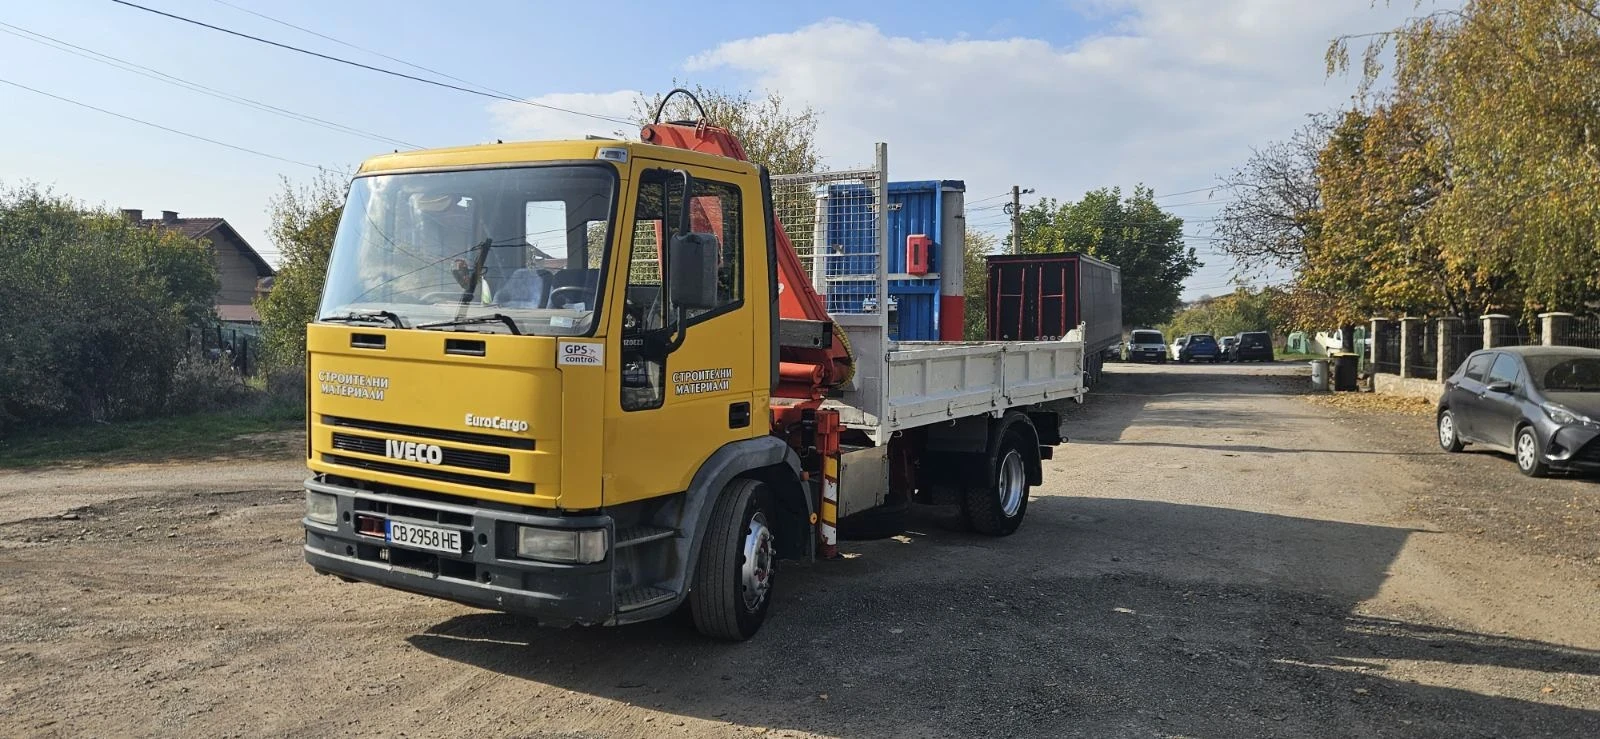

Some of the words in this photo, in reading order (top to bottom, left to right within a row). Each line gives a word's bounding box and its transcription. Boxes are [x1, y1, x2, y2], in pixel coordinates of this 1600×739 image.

[565, 344, 587, 354] GPS
[318, 370, 389, 389] СТРОИТЕЛНИ
[672, 368, 732, 383] СТРОИТЕЛНИ
[321, 384, 384, 401] МАТЕРИАЛИ
[675, 380, 729, 395] МАТЕРИАЛИ
[465, 413, 528, 432] EuroCargo
[385, 439, 443, 465] IVECO
[392, 524, 408, 542] CB
[409, 527, 439, 547] 2958
[441, 532, 459, 550] HE
